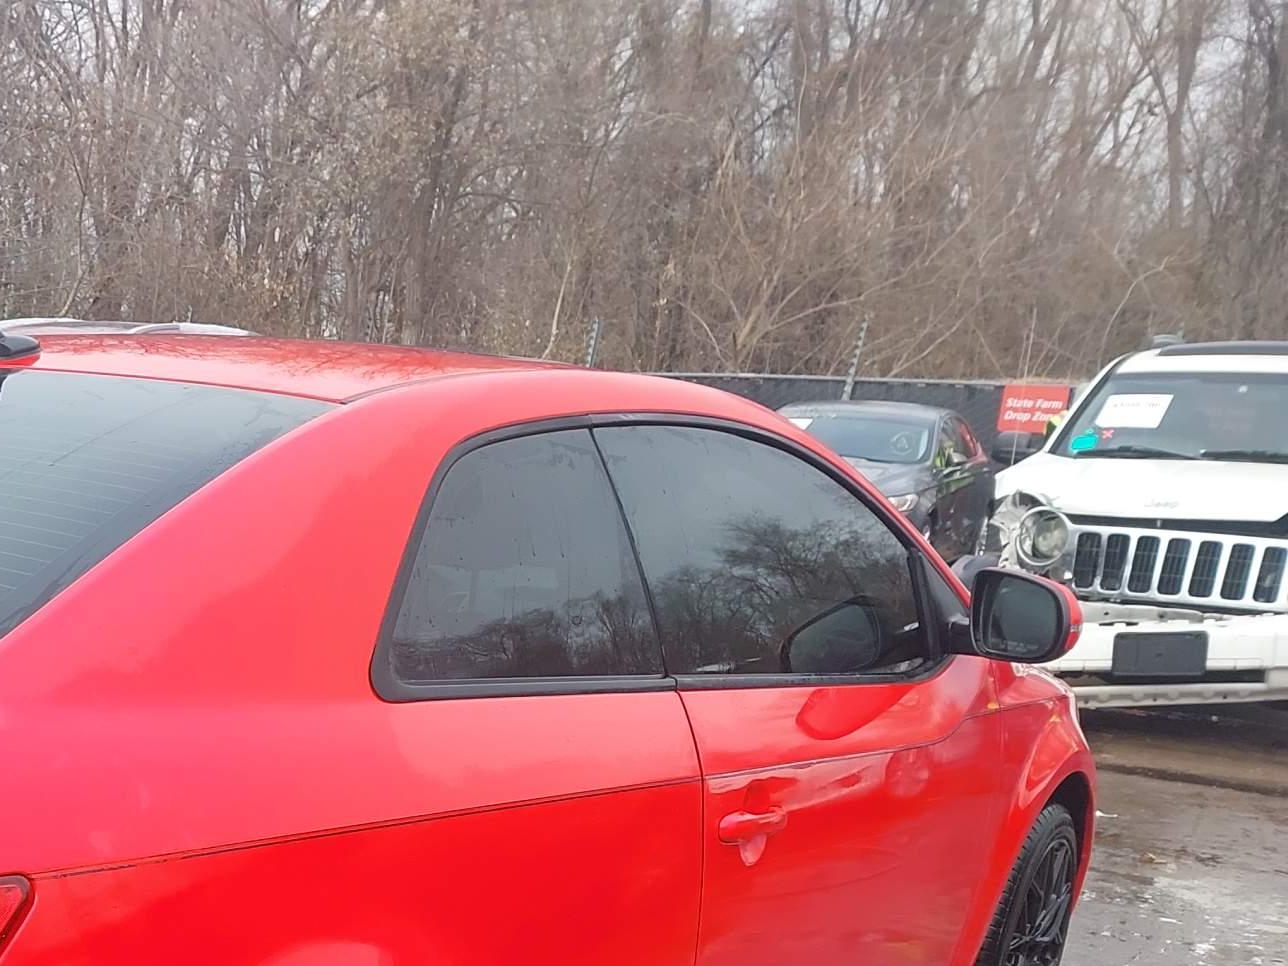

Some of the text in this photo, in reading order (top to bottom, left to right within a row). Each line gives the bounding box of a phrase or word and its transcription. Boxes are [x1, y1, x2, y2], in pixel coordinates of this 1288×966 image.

[1006, 397, 1063, 409] State Farm
[1003, 410, 1051, 423] Drop Zon
